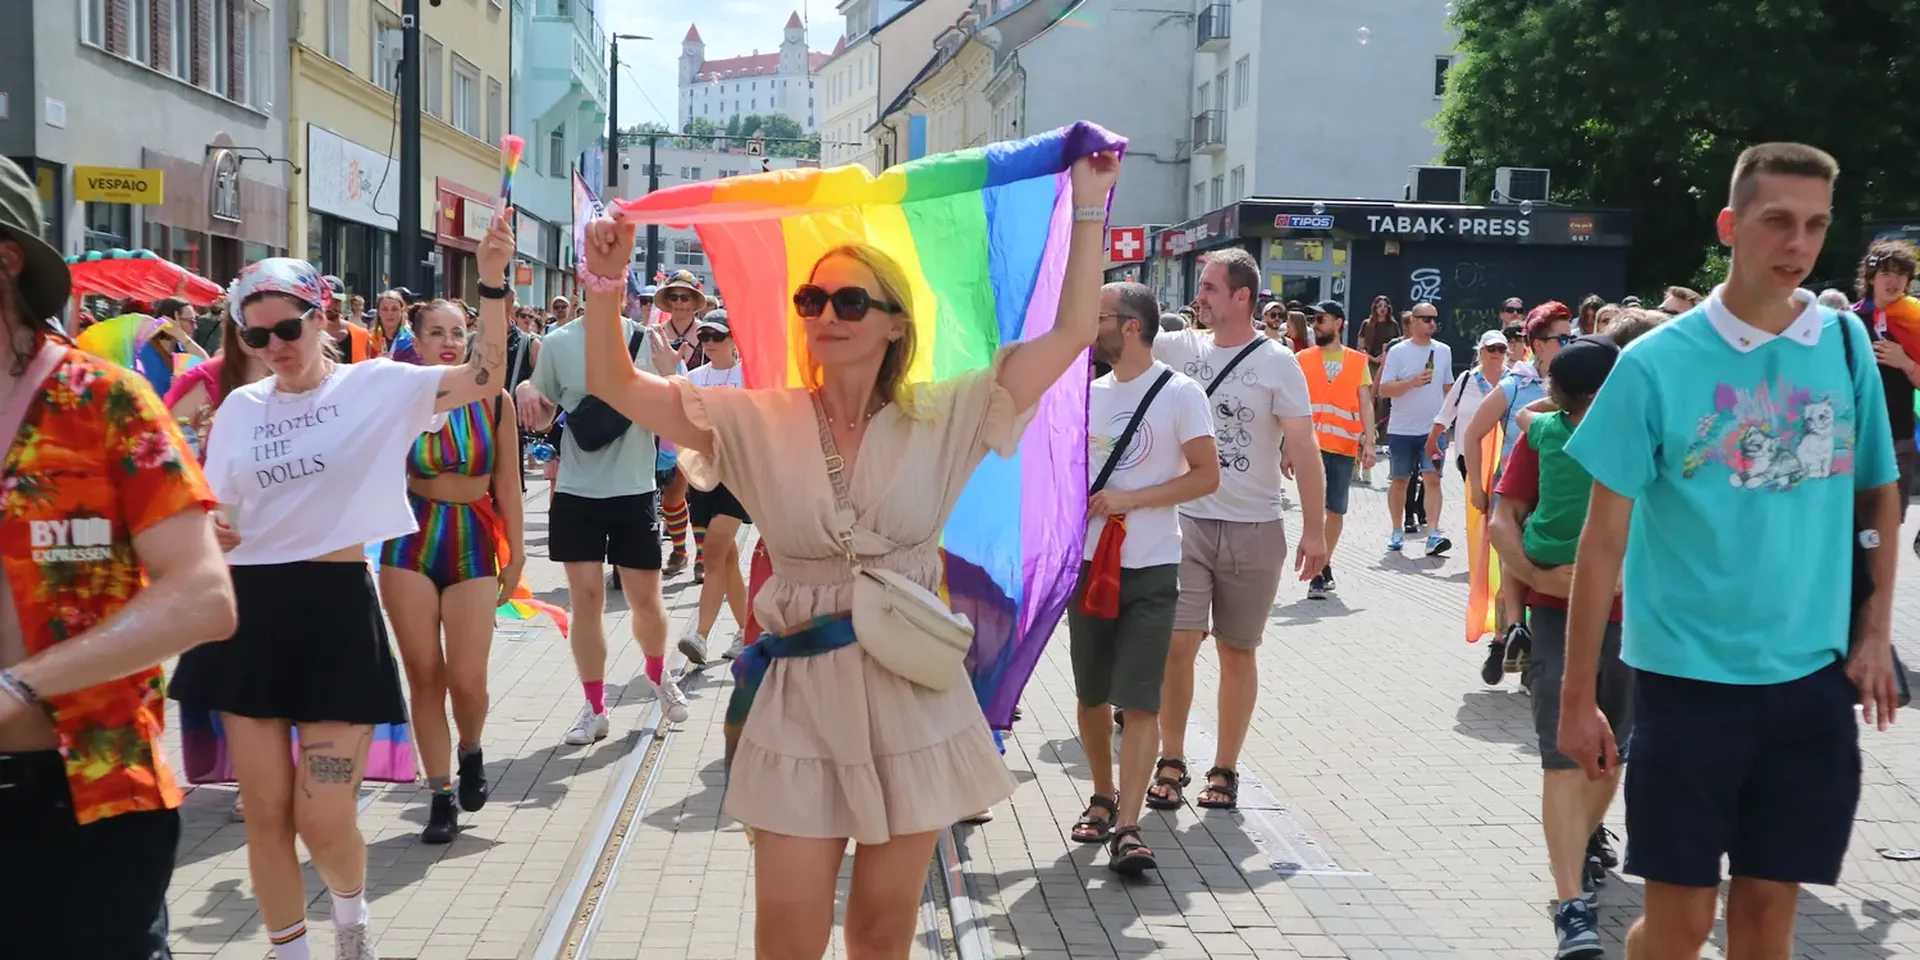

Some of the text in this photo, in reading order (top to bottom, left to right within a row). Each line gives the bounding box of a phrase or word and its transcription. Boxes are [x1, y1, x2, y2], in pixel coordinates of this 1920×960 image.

[87, 177, 148, 192] VESPAIO
[1291, 217, 1331, 227] TIPOS
[1367, 215, 1531, 236] TABAK PRESS
[252, 403, 341, 440] PROTECT
[251, 439, 292, 462] THE
[255, 453, 325, 489] DOLLS
[30, 519, 70, 547] BY
[31, 546, 112, 563] EXPRESSEN
